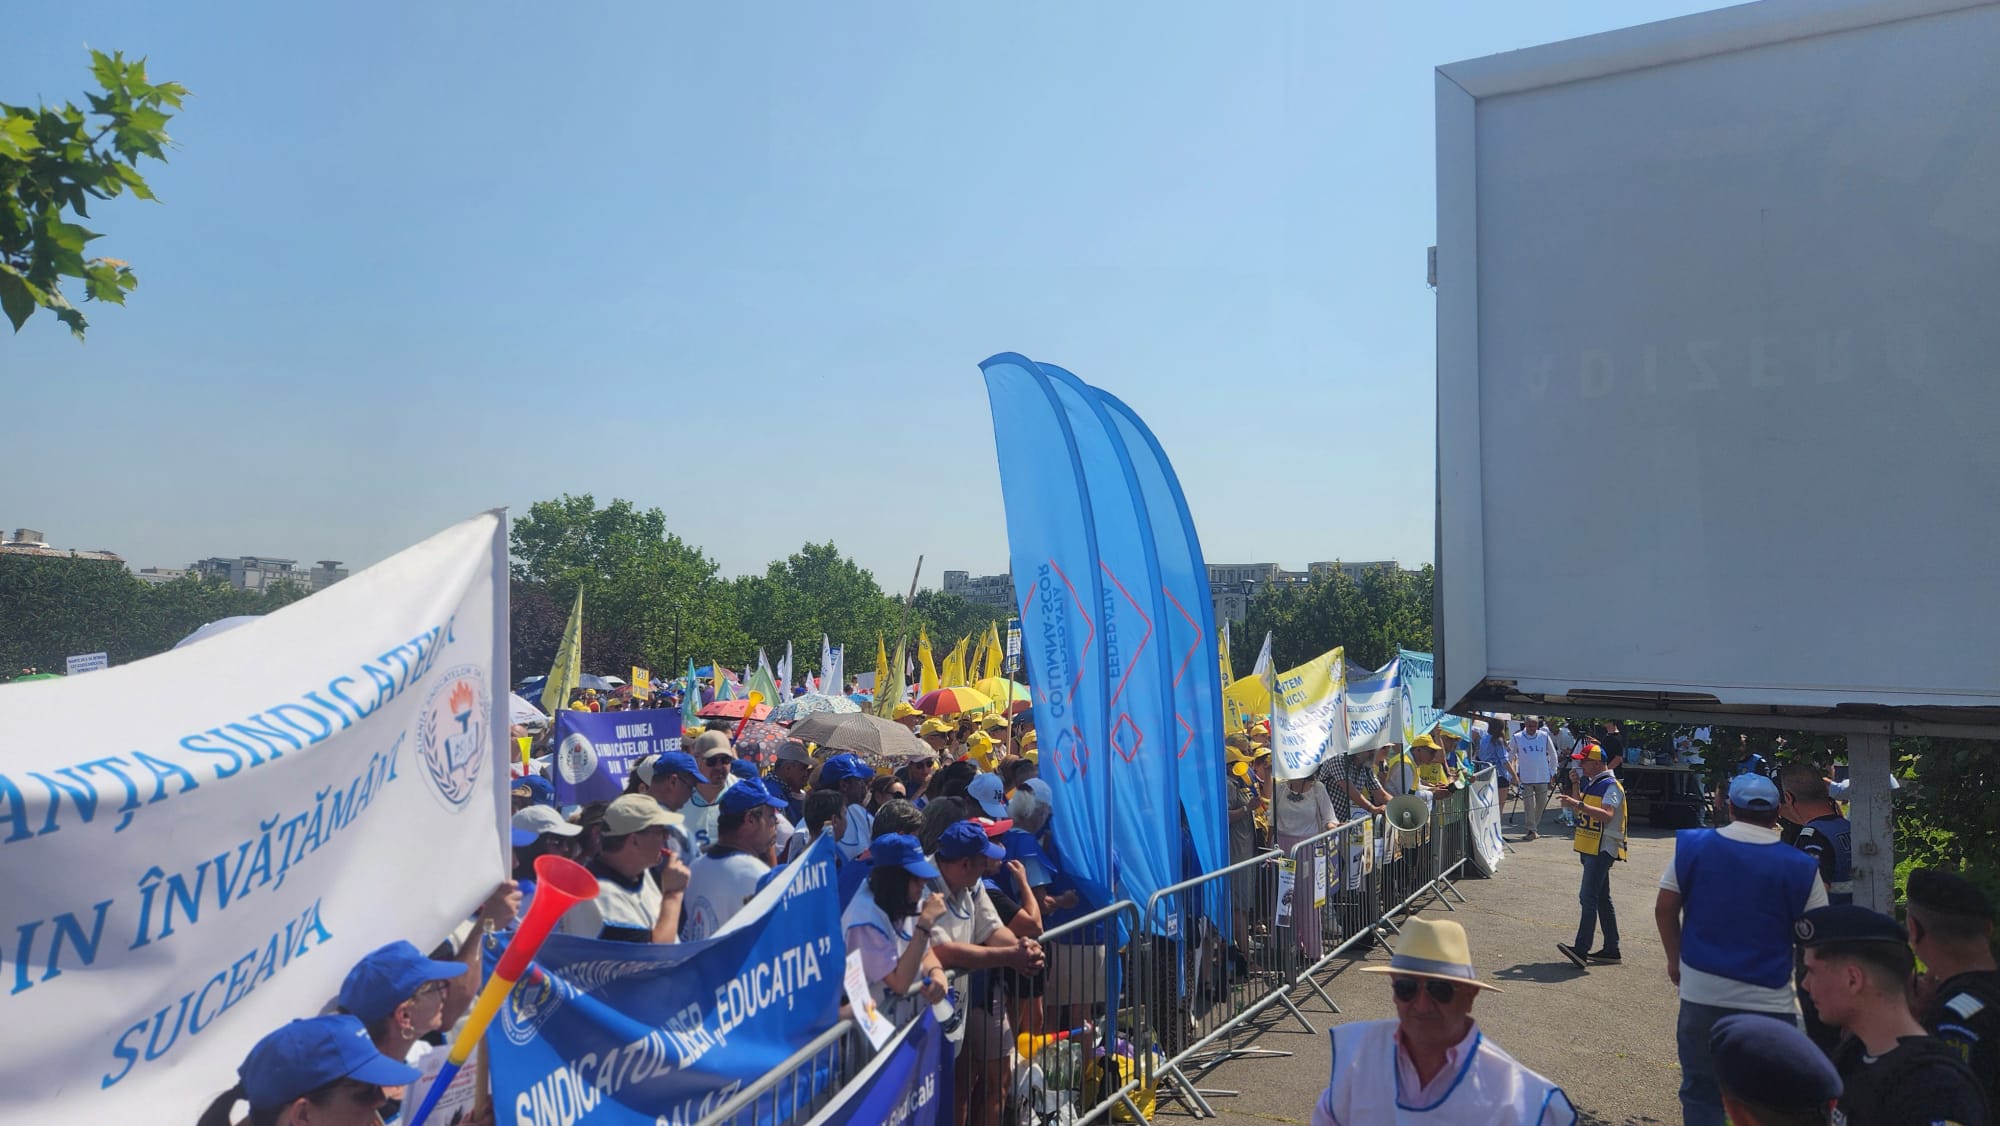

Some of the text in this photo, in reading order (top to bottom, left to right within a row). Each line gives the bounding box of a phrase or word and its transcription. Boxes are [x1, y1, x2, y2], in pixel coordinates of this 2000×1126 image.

[595, 737, 683, 757] SINDICATELOR LIBERE
[615, 722, 654, 739] UNIUNEA
[0, 730, 405, 996] IN ÎNVĂȚĂMÂNT
[101, 897, 333, 1091] SUCEAVA
[515, 1034, 671, 1126] SINDICATUL
[663, 1002, 717, 1070] LIBER
[713, 936, 832, 1048] „EDUCAȚIA”
